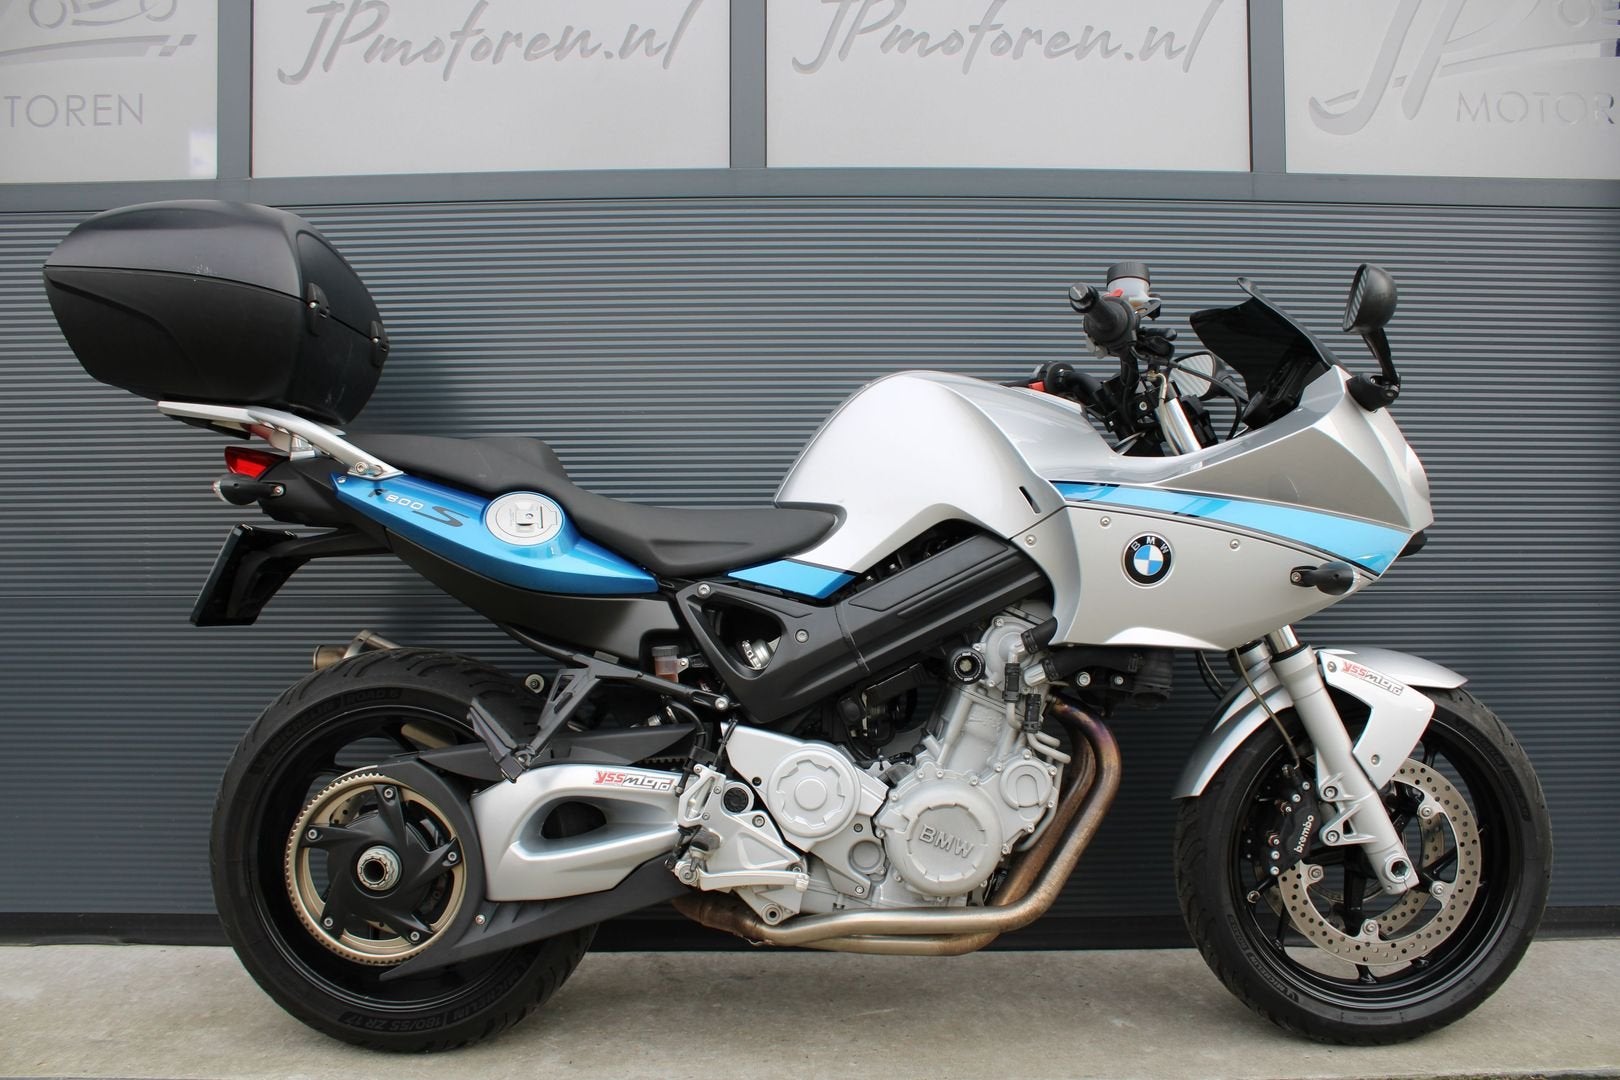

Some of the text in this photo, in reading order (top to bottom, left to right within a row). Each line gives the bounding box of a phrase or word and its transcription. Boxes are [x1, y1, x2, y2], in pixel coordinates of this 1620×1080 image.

[277, 0, 702, 85] JPmotoren.nl
[3, 93, 144, 128] TOREN
[1456, 91, 1615, 124] MOTOR
[385, 494, 424, 510] 800
[411, 505, 470, 528] S
[1131, 536, 1169, 554] BMW
[919, 824, 975, 859] BMW
[1293, 814, 1315, 853] brembo
[364, 1018, 388, 1032] ZR
[390, 1016, 442, 1033] 180/55
